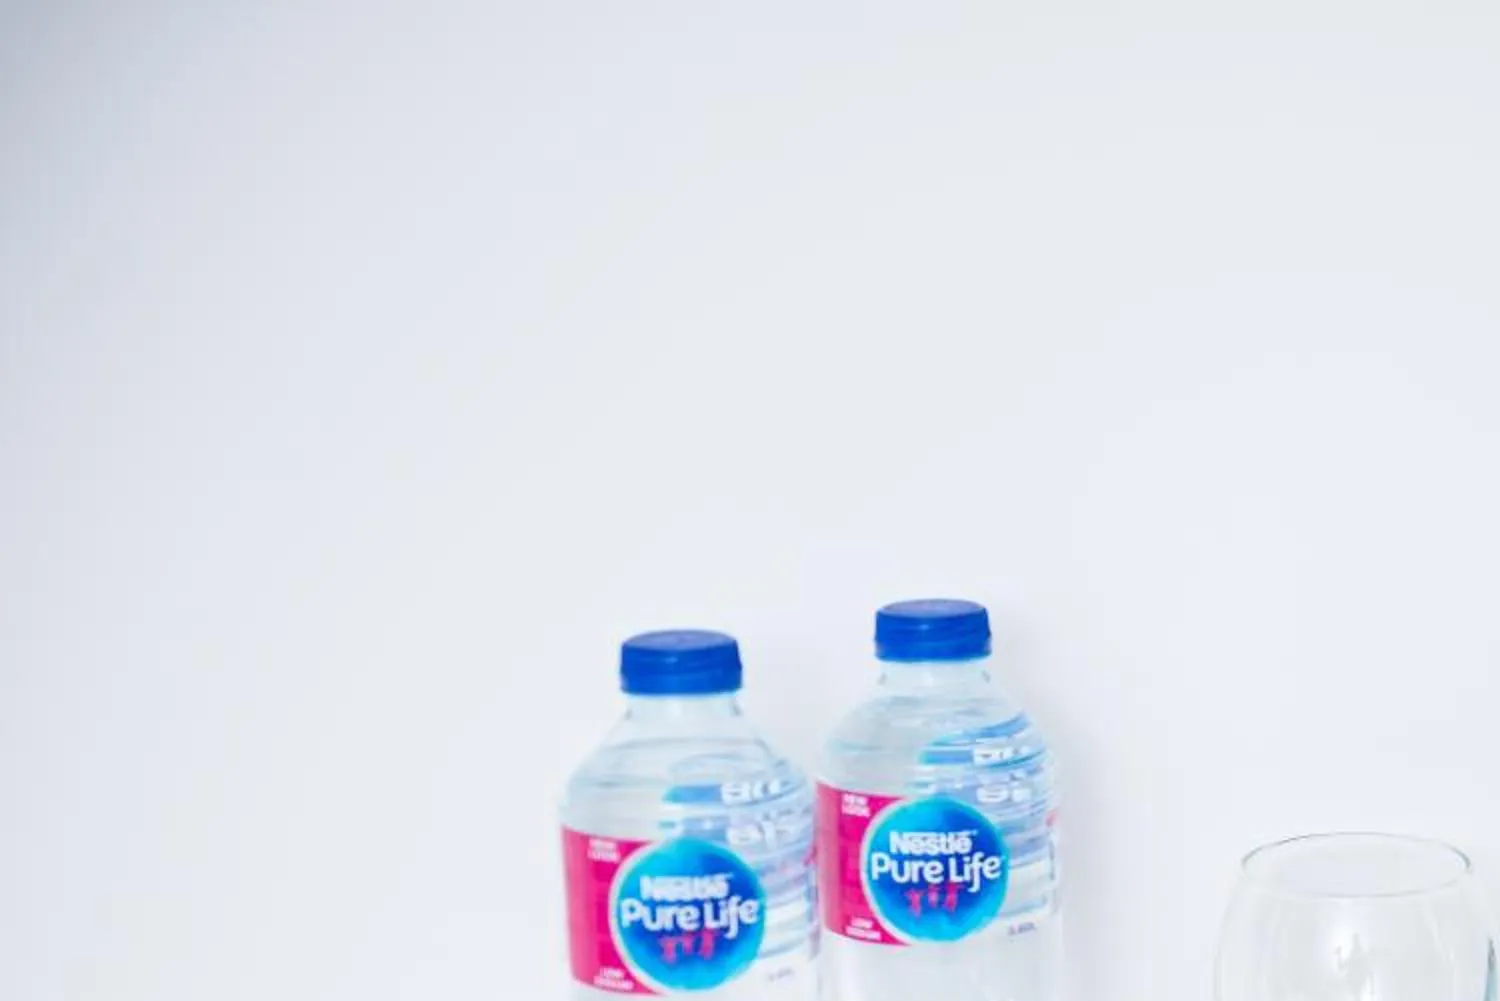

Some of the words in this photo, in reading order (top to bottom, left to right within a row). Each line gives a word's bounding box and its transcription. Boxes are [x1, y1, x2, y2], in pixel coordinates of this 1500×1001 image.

[889, 829, 977, 856] Nestlé
[871, 852, 944, 884] Pure
[949, 852, 1000, 892] Life
[620, 897, 701, 931] Pure
[703, 894, 761, 939] Life
